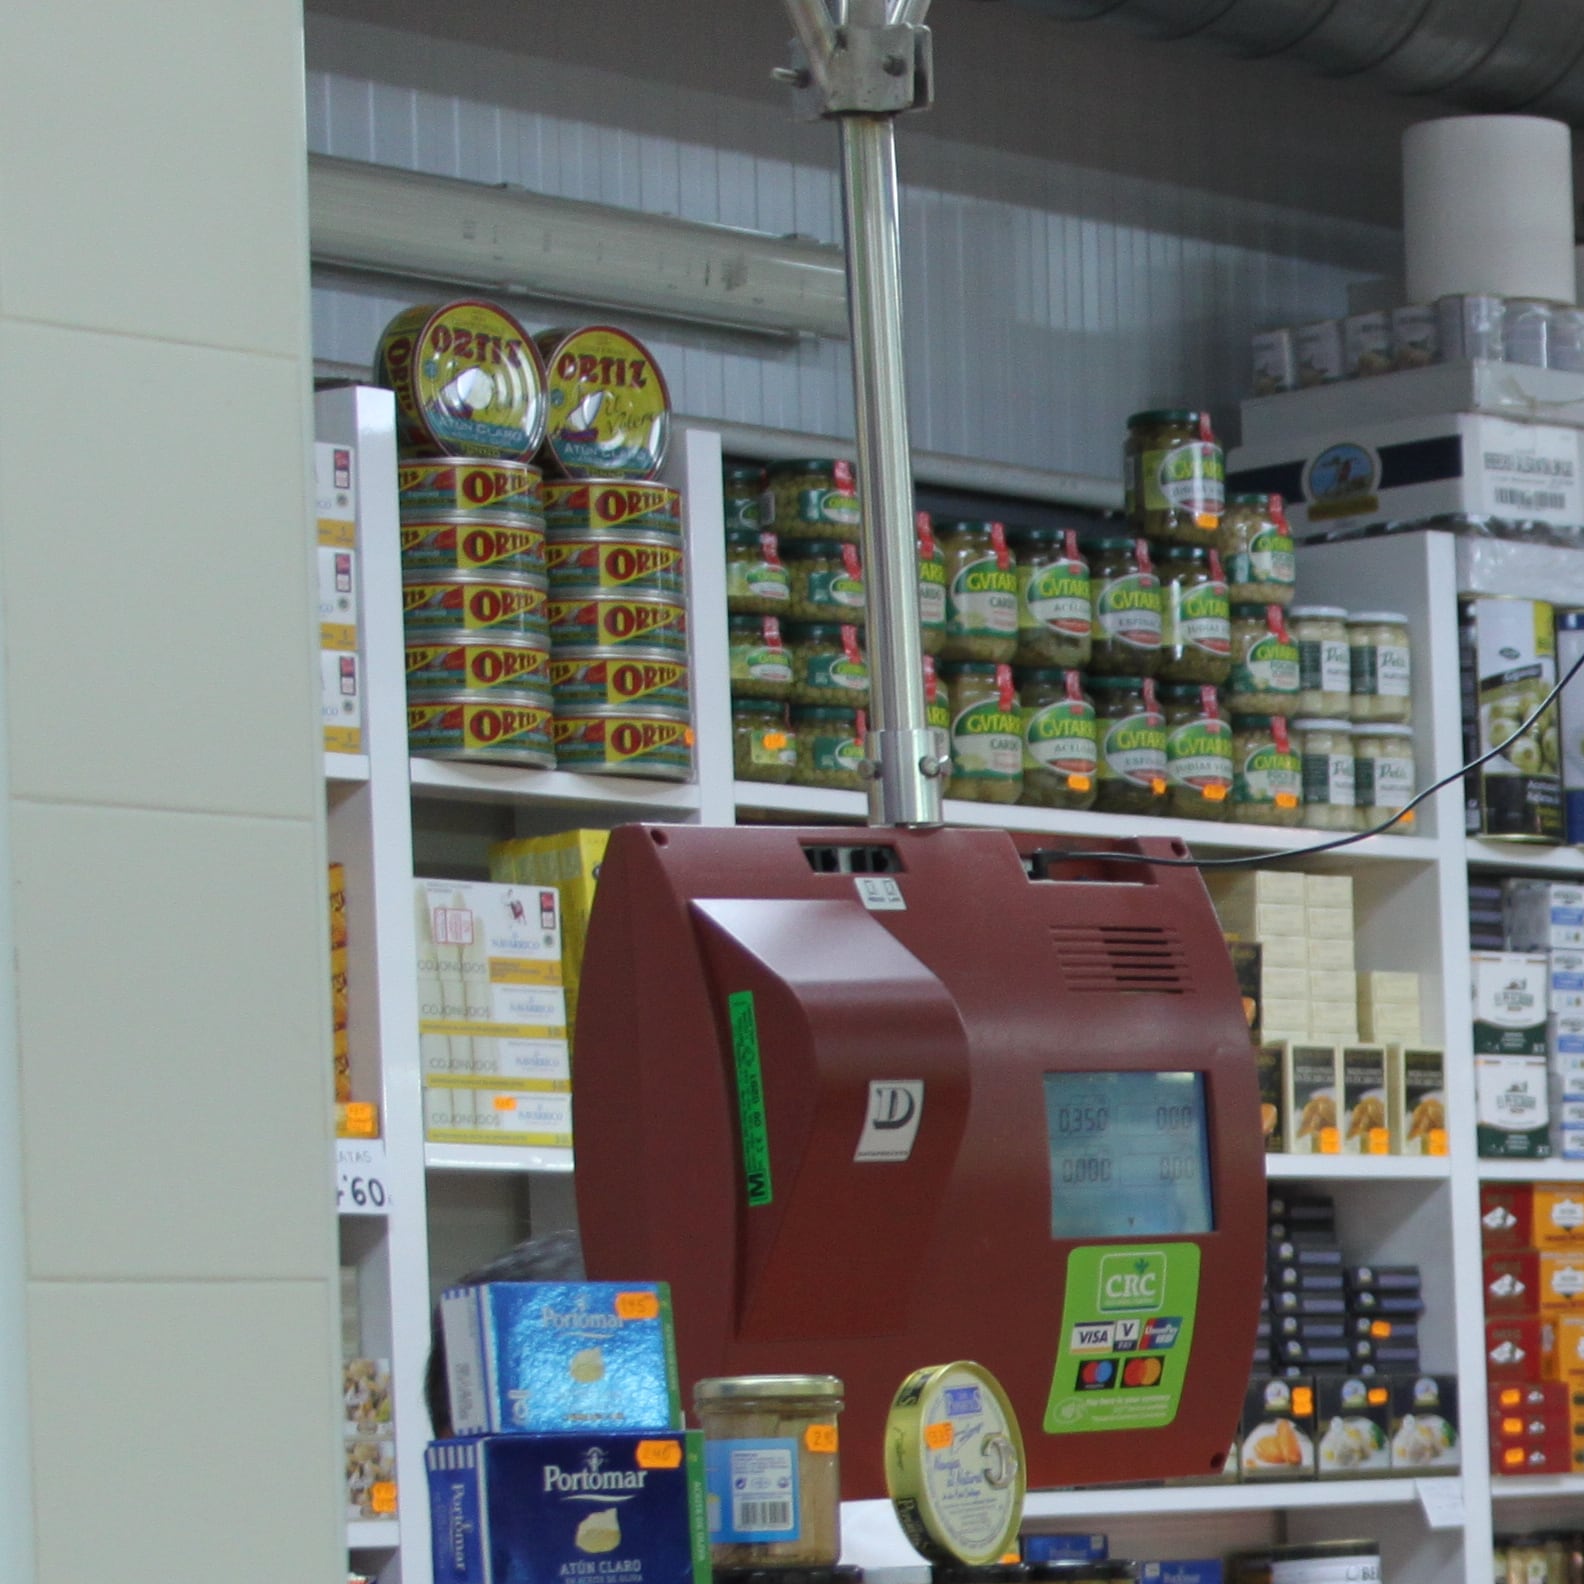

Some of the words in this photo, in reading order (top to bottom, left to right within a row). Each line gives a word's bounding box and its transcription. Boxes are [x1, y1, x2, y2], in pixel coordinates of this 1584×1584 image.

[557, 352, 648, 388] ORTIZ
[1105, 1272, 1157, 1300] CRC
[1078, 1329, 1109, 1346] VISA
[542, 1464, 649, 1492] Portomar
[450, 1482, 472, 1571] Portomar
[560, 1559, 595, 1577] ATÚN
[598, 1559, 642, 1575] CLARO
